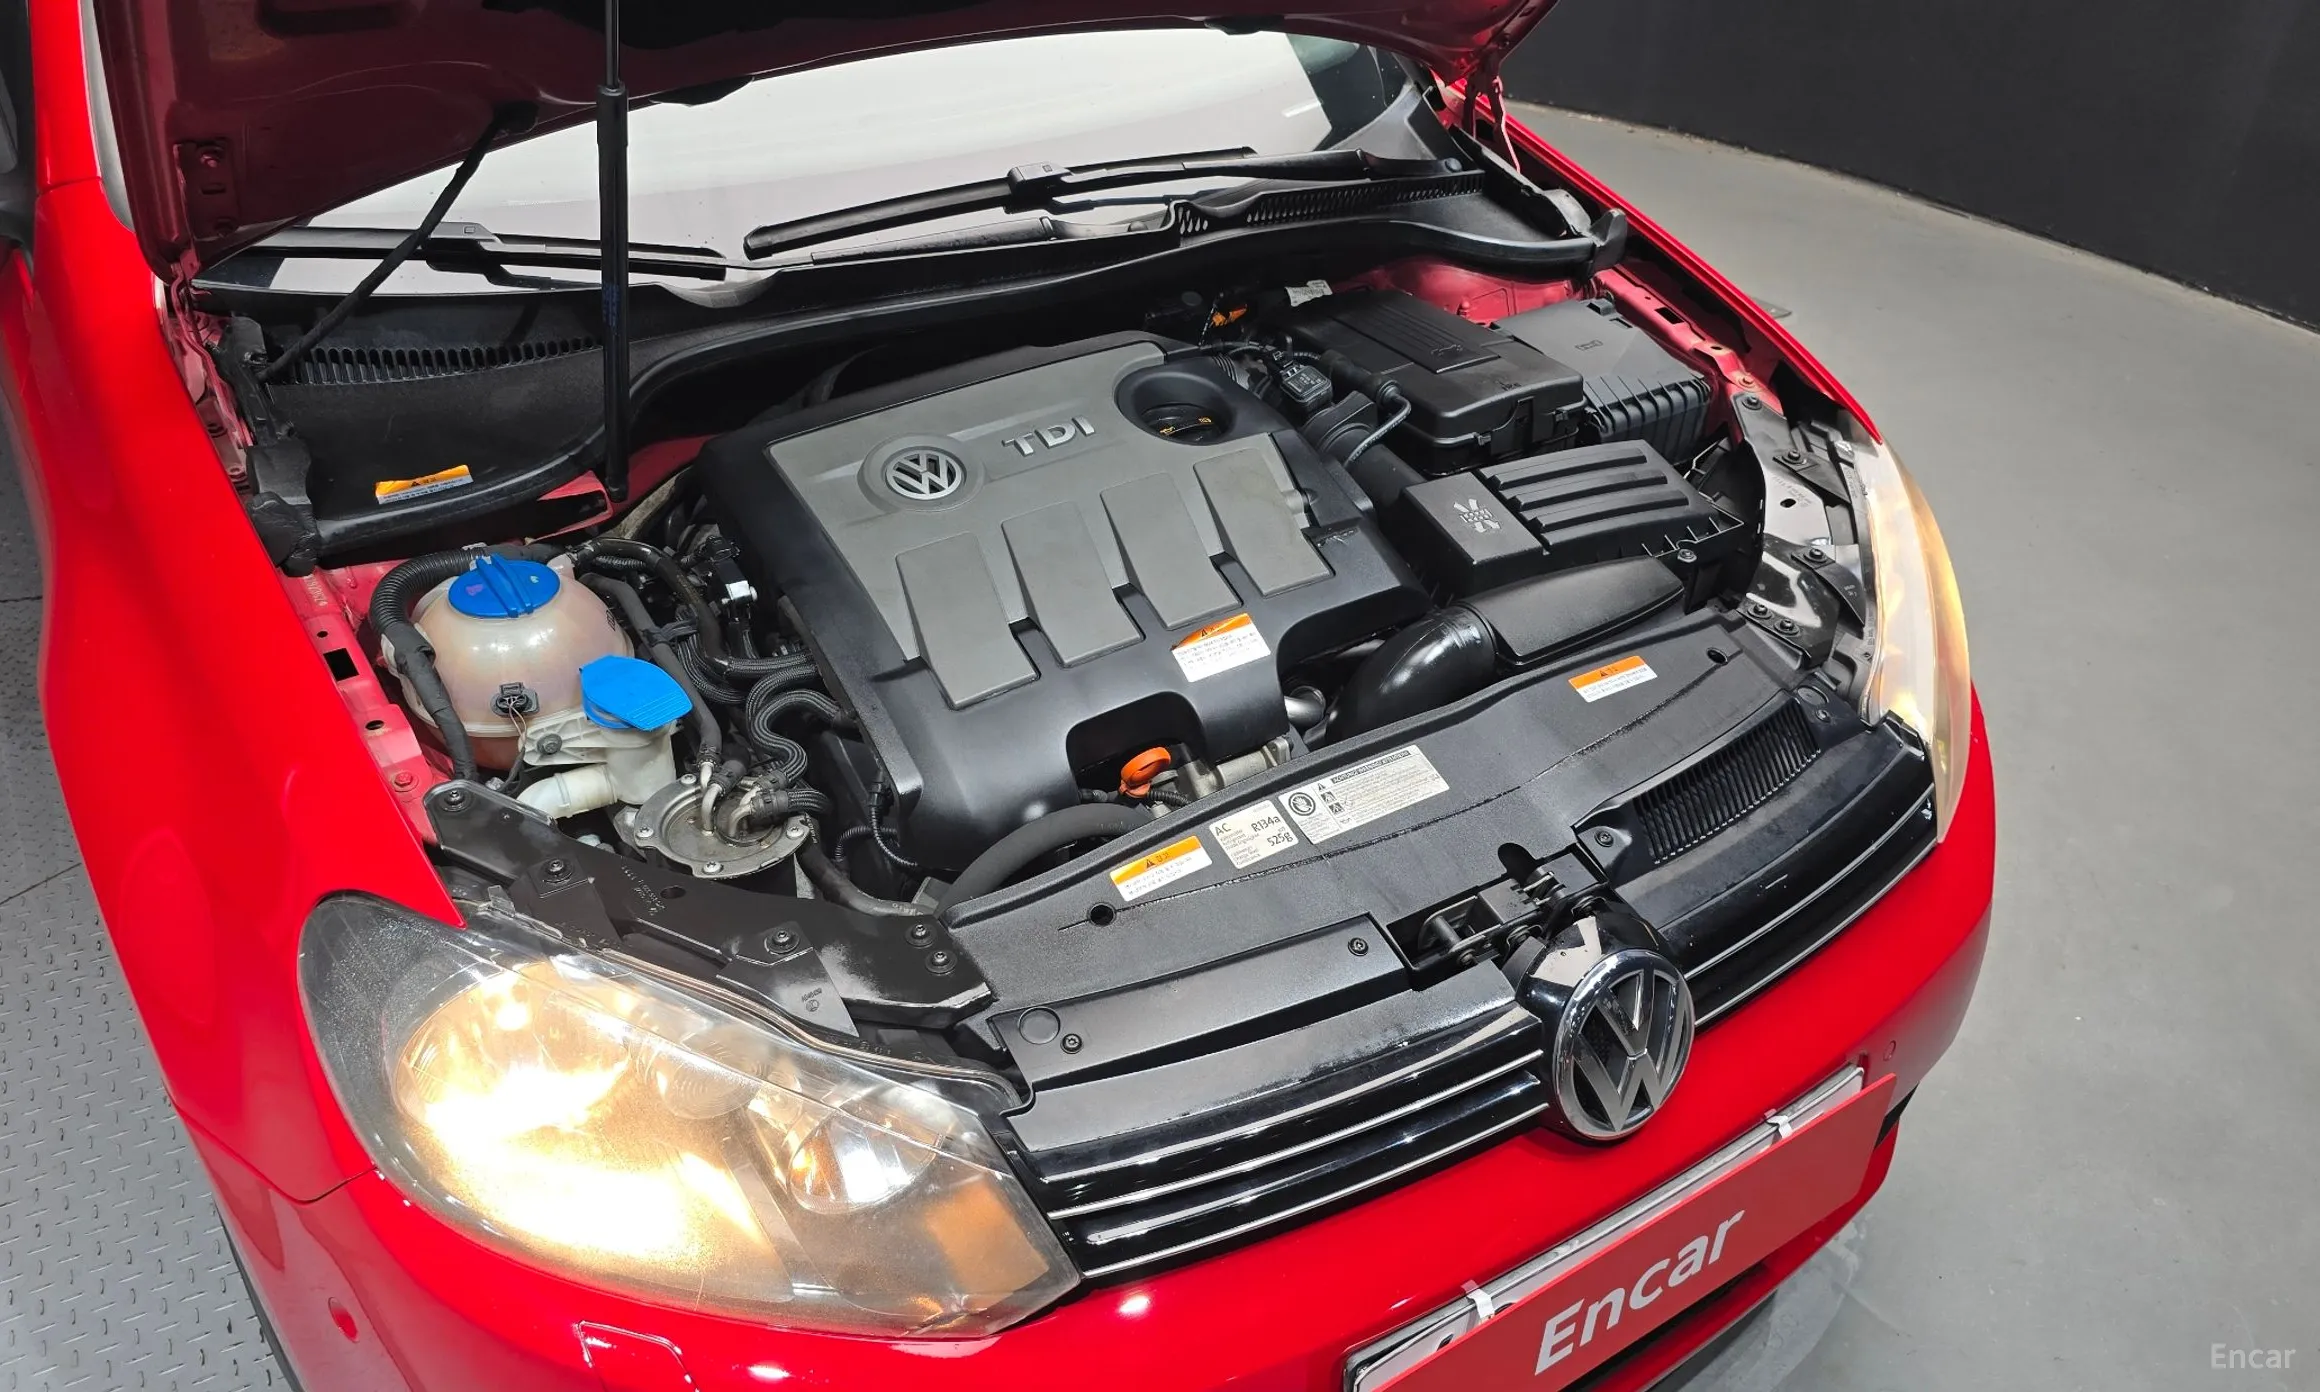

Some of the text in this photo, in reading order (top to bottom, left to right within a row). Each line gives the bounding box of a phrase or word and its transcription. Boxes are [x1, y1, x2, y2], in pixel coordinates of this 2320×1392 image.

[1002, 415, 1096, 457] TDI
[1214, 822, 1231, 836] AC
[1250, 815, 1281, 832] R134a
[1266, 831, 1294, 847] 525g
[1534, 1209, 1746, 1376] Encar
